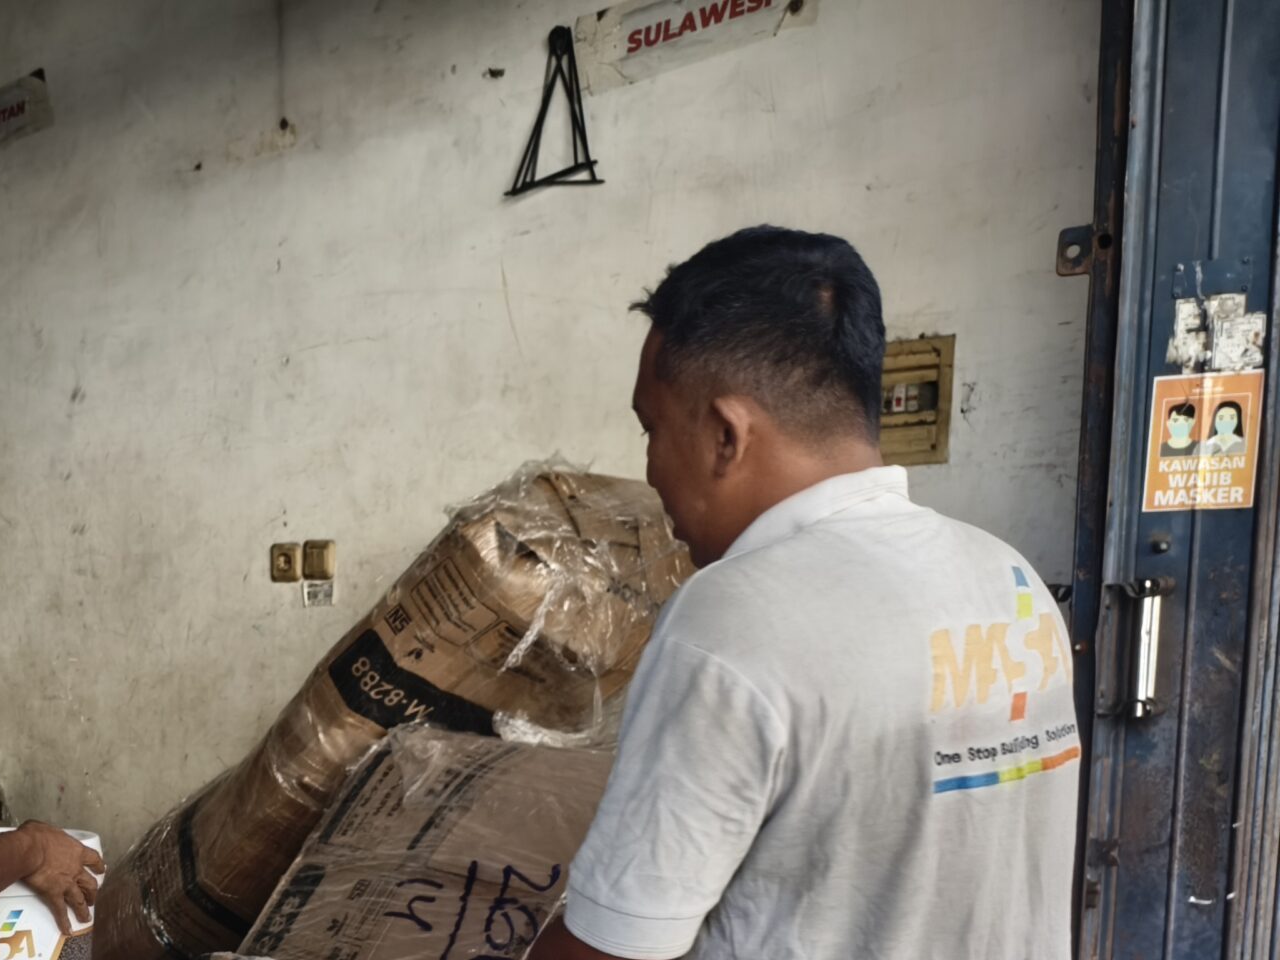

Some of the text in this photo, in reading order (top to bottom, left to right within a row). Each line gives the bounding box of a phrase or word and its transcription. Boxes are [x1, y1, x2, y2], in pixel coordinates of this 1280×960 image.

[1158, 456, 1246, 473] KAWASAN
[1168, 471, 1233, 488] WAJIB
[1153, 486, 1245, 507] MASKER
[930, 612, 1073, 714] MASA
[935, 722, 1076, 767] One Stop Building Solution
